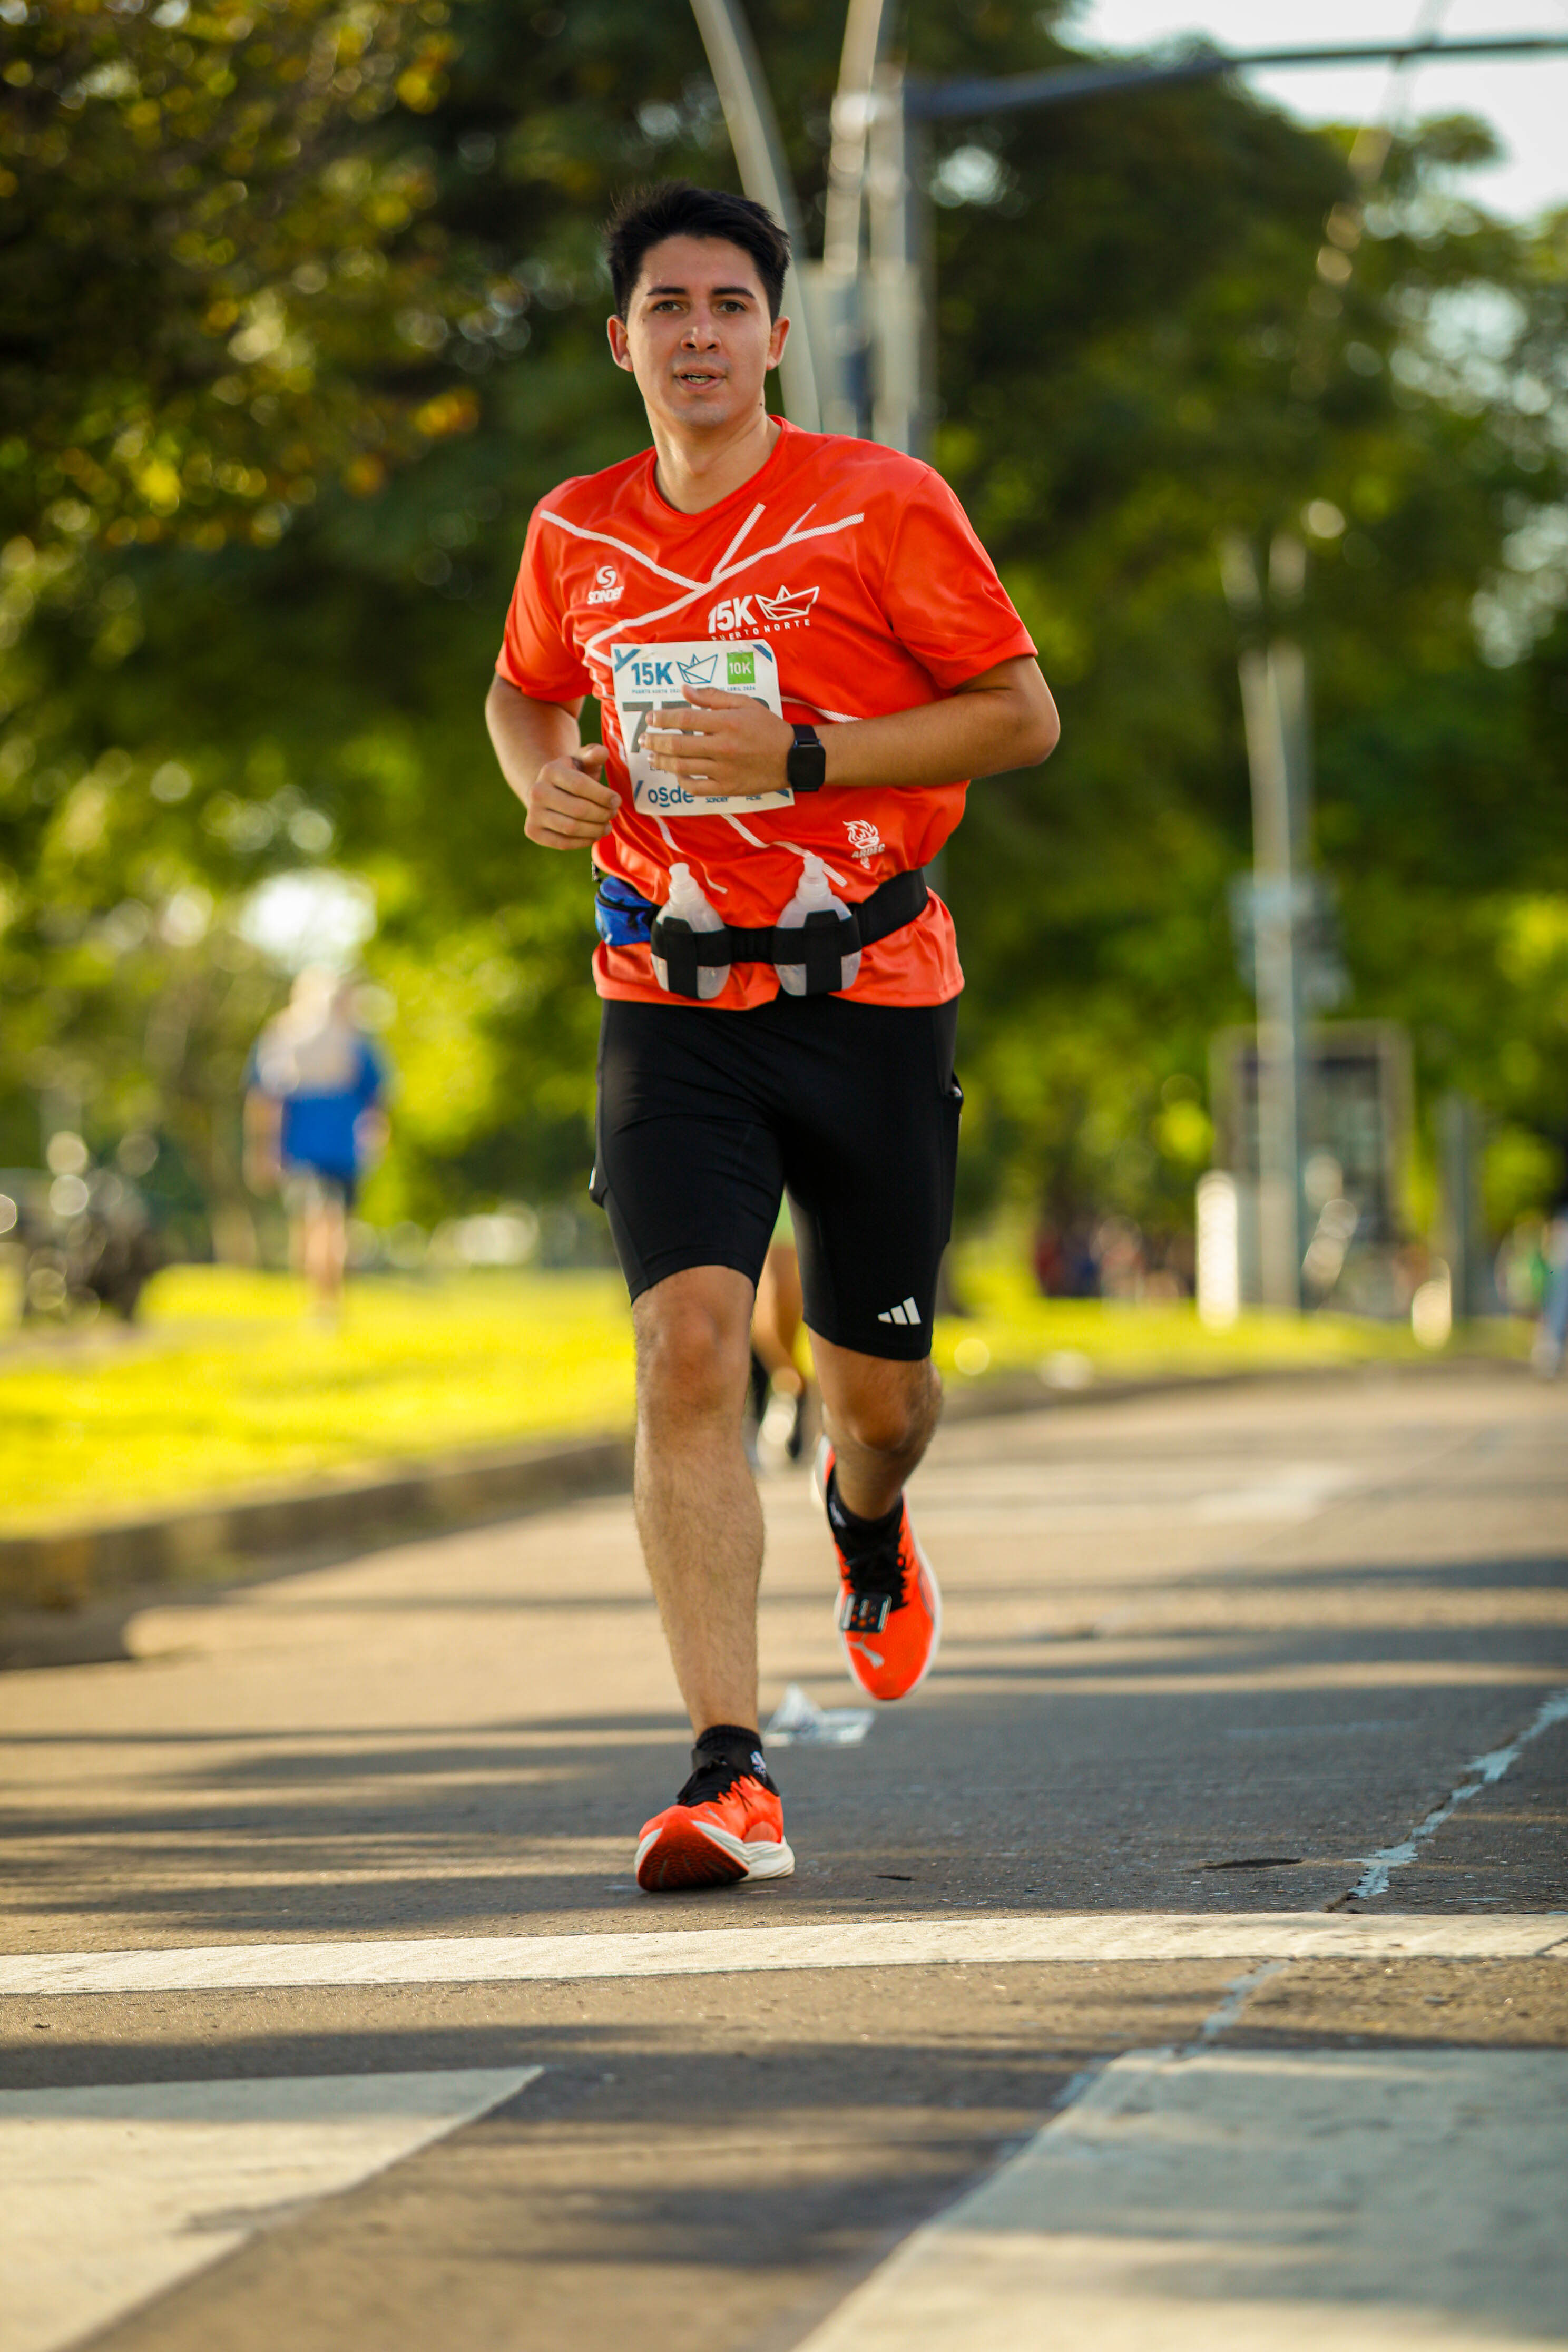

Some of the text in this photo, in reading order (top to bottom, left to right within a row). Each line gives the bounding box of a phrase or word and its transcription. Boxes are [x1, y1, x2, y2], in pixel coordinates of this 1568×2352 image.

[708, 595, 758, 634] 15K
[631, 661, 674, 685] 15K
[729, 661, 752, 675] 10K
